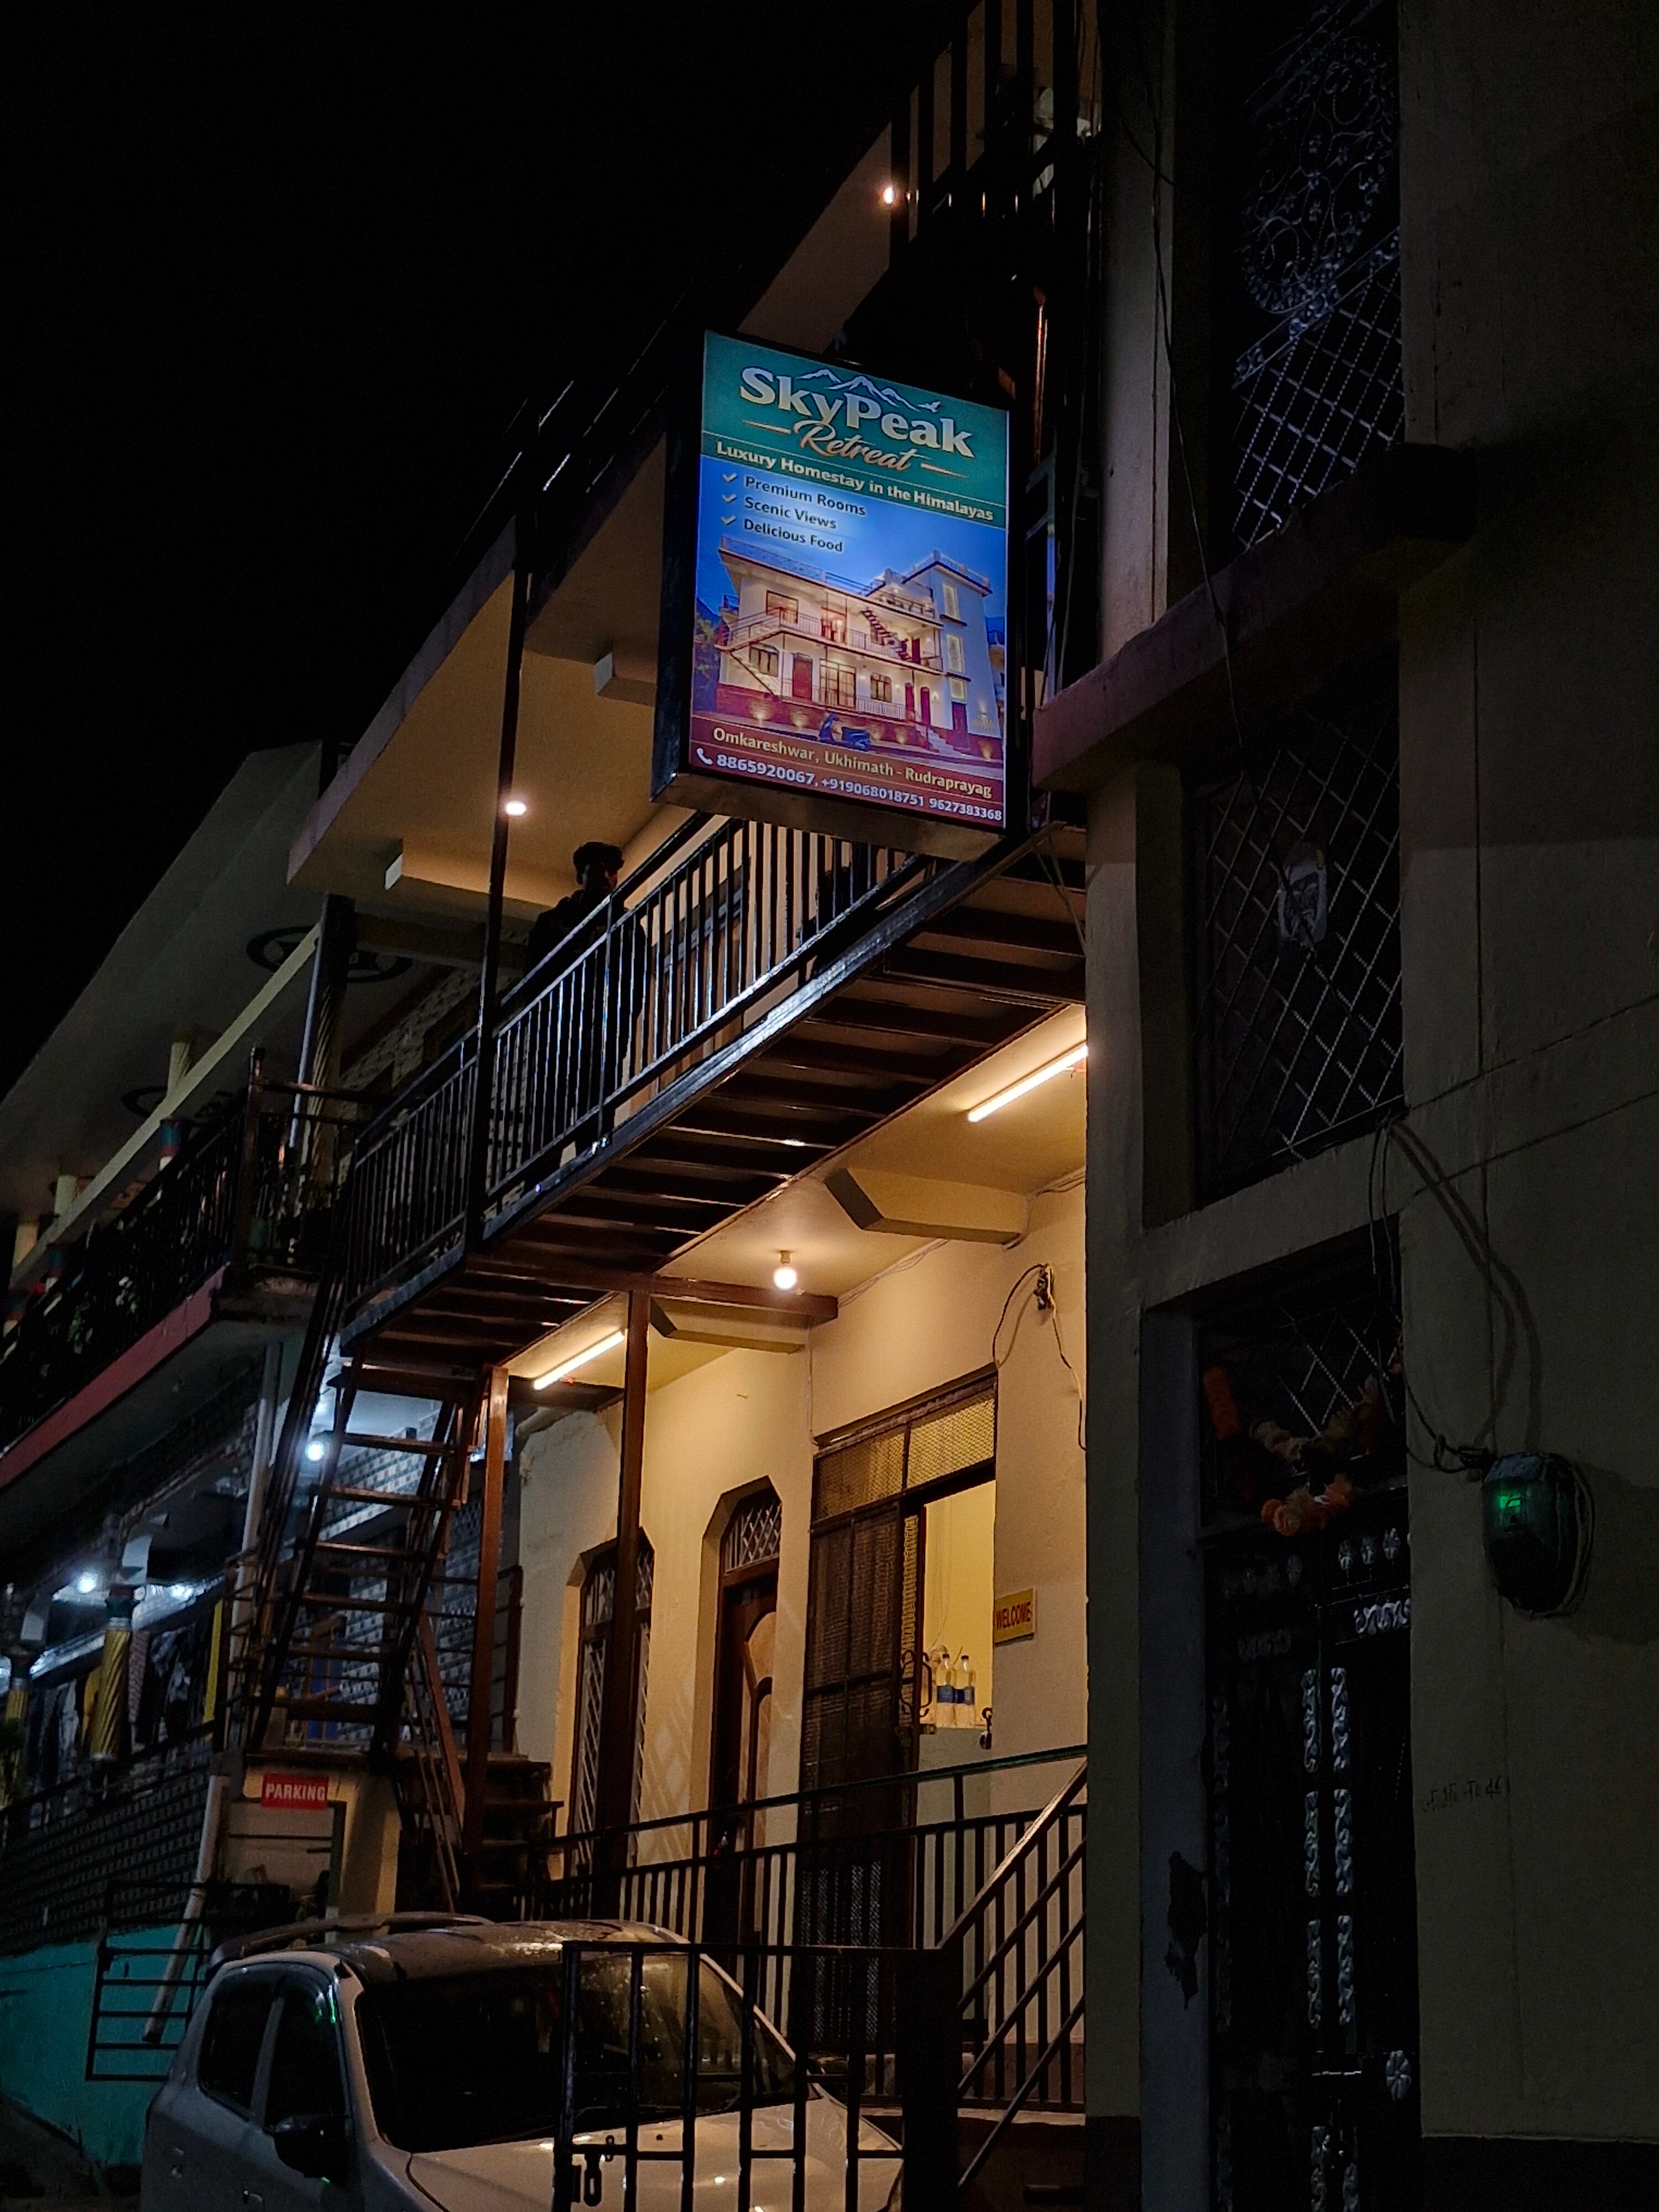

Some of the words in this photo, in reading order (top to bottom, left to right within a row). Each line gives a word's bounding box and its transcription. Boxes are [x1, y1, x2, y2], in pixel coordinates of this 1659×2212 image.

[739, 367, 975, 458] SkyPeak
[794, 419, 932, 472] Retreat
[717, 442, 776, 469] Luxury
[781, 458, 865, 492] Homestay
[869, 480, 884, 495] in
[887, 486, 911, 502] the
[914, 491, 994, 521] Himalayas
[745, 475, 812, 503] Premium
[817, 493, 867, 517] Rooms
[744, 497, 791, 519] Scenic
[795, 509, 837, 530] Views
[744, 519, 806, 544] Delicious
[810, 534, 843, 552] Food
[713, 728, 819, 763] Omkareshwar,
[825, 751, 894, 776] Ukhimath
[905, 767, 993, 799] Rudraprayag
[996, 1601, 1031, 1630] WELCOME
[265, 1783, 326, 1801] PARKING
